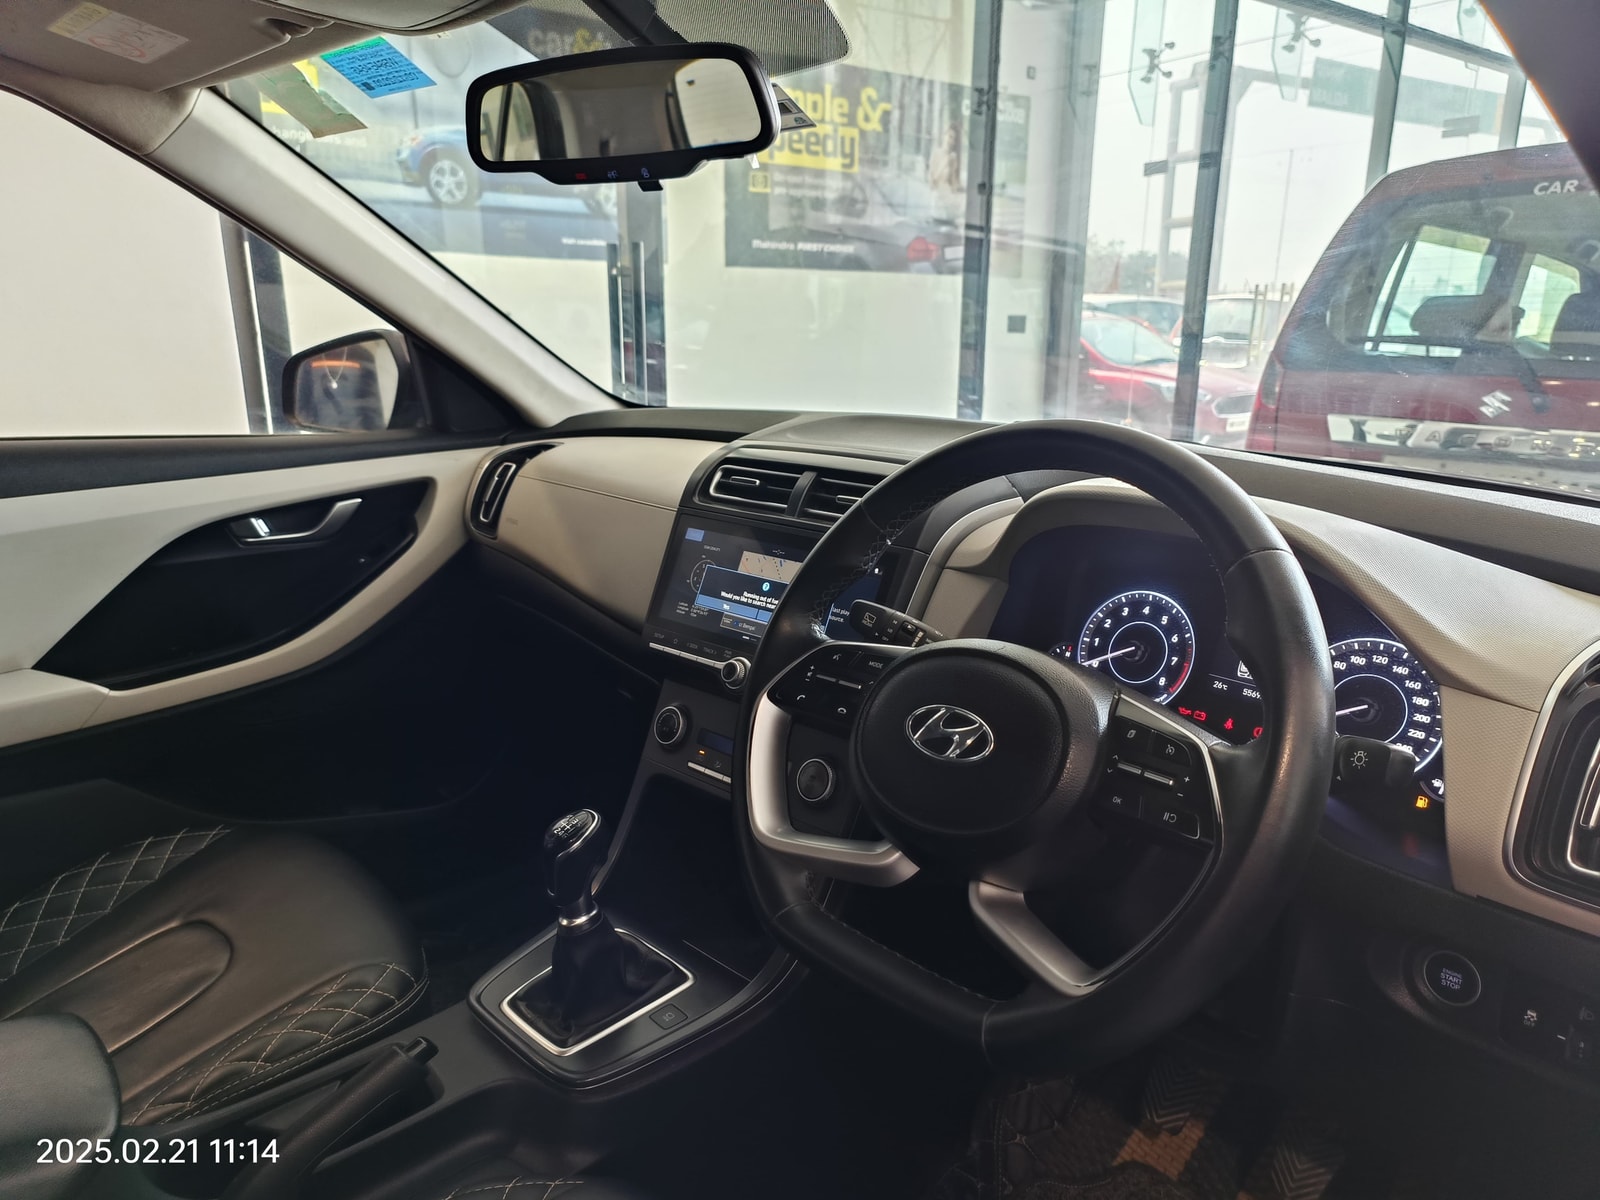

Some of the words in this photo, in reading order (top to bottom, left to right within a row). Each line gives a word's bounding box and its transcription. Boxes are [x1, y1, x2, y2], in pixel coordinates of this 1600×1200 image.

[768, 128, 856, 169] peedy
[1533, 180, 1579, 196] CAR
[721, 591, 734, 600] Would
[752, 599, 767, 607] search
[743, 591, 760, 600] Running
[1122, 607, 1130, 616] 3
[1142, 606, 1150, 615] 4
[1104, 619, 1112, 628] 2
[1161, 616, 1169, 625] 5
[1094, 637, 1100, 646] 1
[1171, 634, 1178, 643] 6
[1170, 657, 1178, 666] 7
[1350, 655, 1367, 666] 100
[1372, 655, 1389, 665] 120
[1333, 661, 1347, 671] 80
[1392, 665, 1409, 676] 140
[1158, 677, 1166, 686] 8
[1404, 680, 1422, 690] 160
[1412, 696, 1430, 707] 180
[1413, 714, 1431, 723] 200
[1408, 729, 1425, 739] 220
[1112, 796, 1122, 804] OK
[1440, 972, 1463, 985] START
[1440, 979, 1461, 990] STOP
